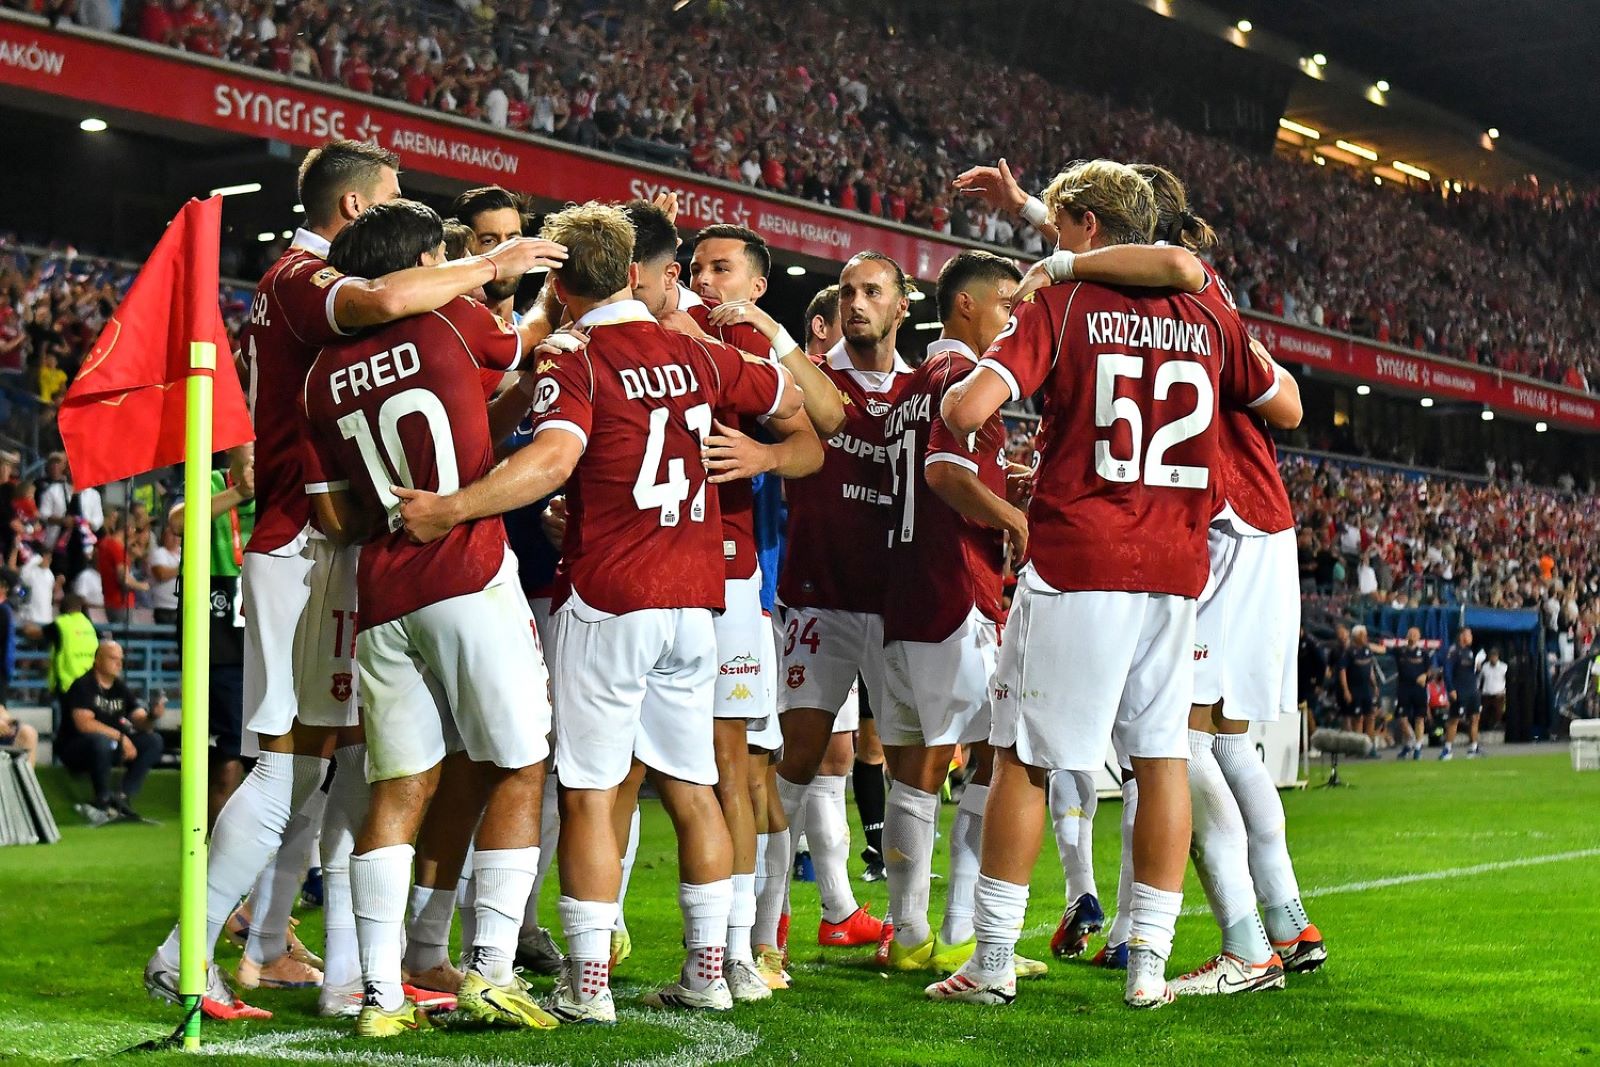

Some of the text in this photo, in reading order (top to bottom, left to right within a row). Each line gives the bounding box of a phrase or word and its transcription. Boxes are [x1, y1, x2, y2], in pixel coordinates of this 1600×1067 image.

[391, 129, 448, 157] ARENA
[450, 143, 519, 174] KRAKÓW
[758, 213, 799, 234] ARENA
[800, 225, 850, 247] KRAKÓW
[1086, 308, 1211, 356] KRZYŻANOWSKI
[329, 341, 421, 405] FRED
[1094, 353, 1215, 489] 52
[336, 387, 460, 534] 10
[632, 402, 713, 527] 41
[842, 483, 893, 505] WIE
[783, 616, 821, 657] 34
